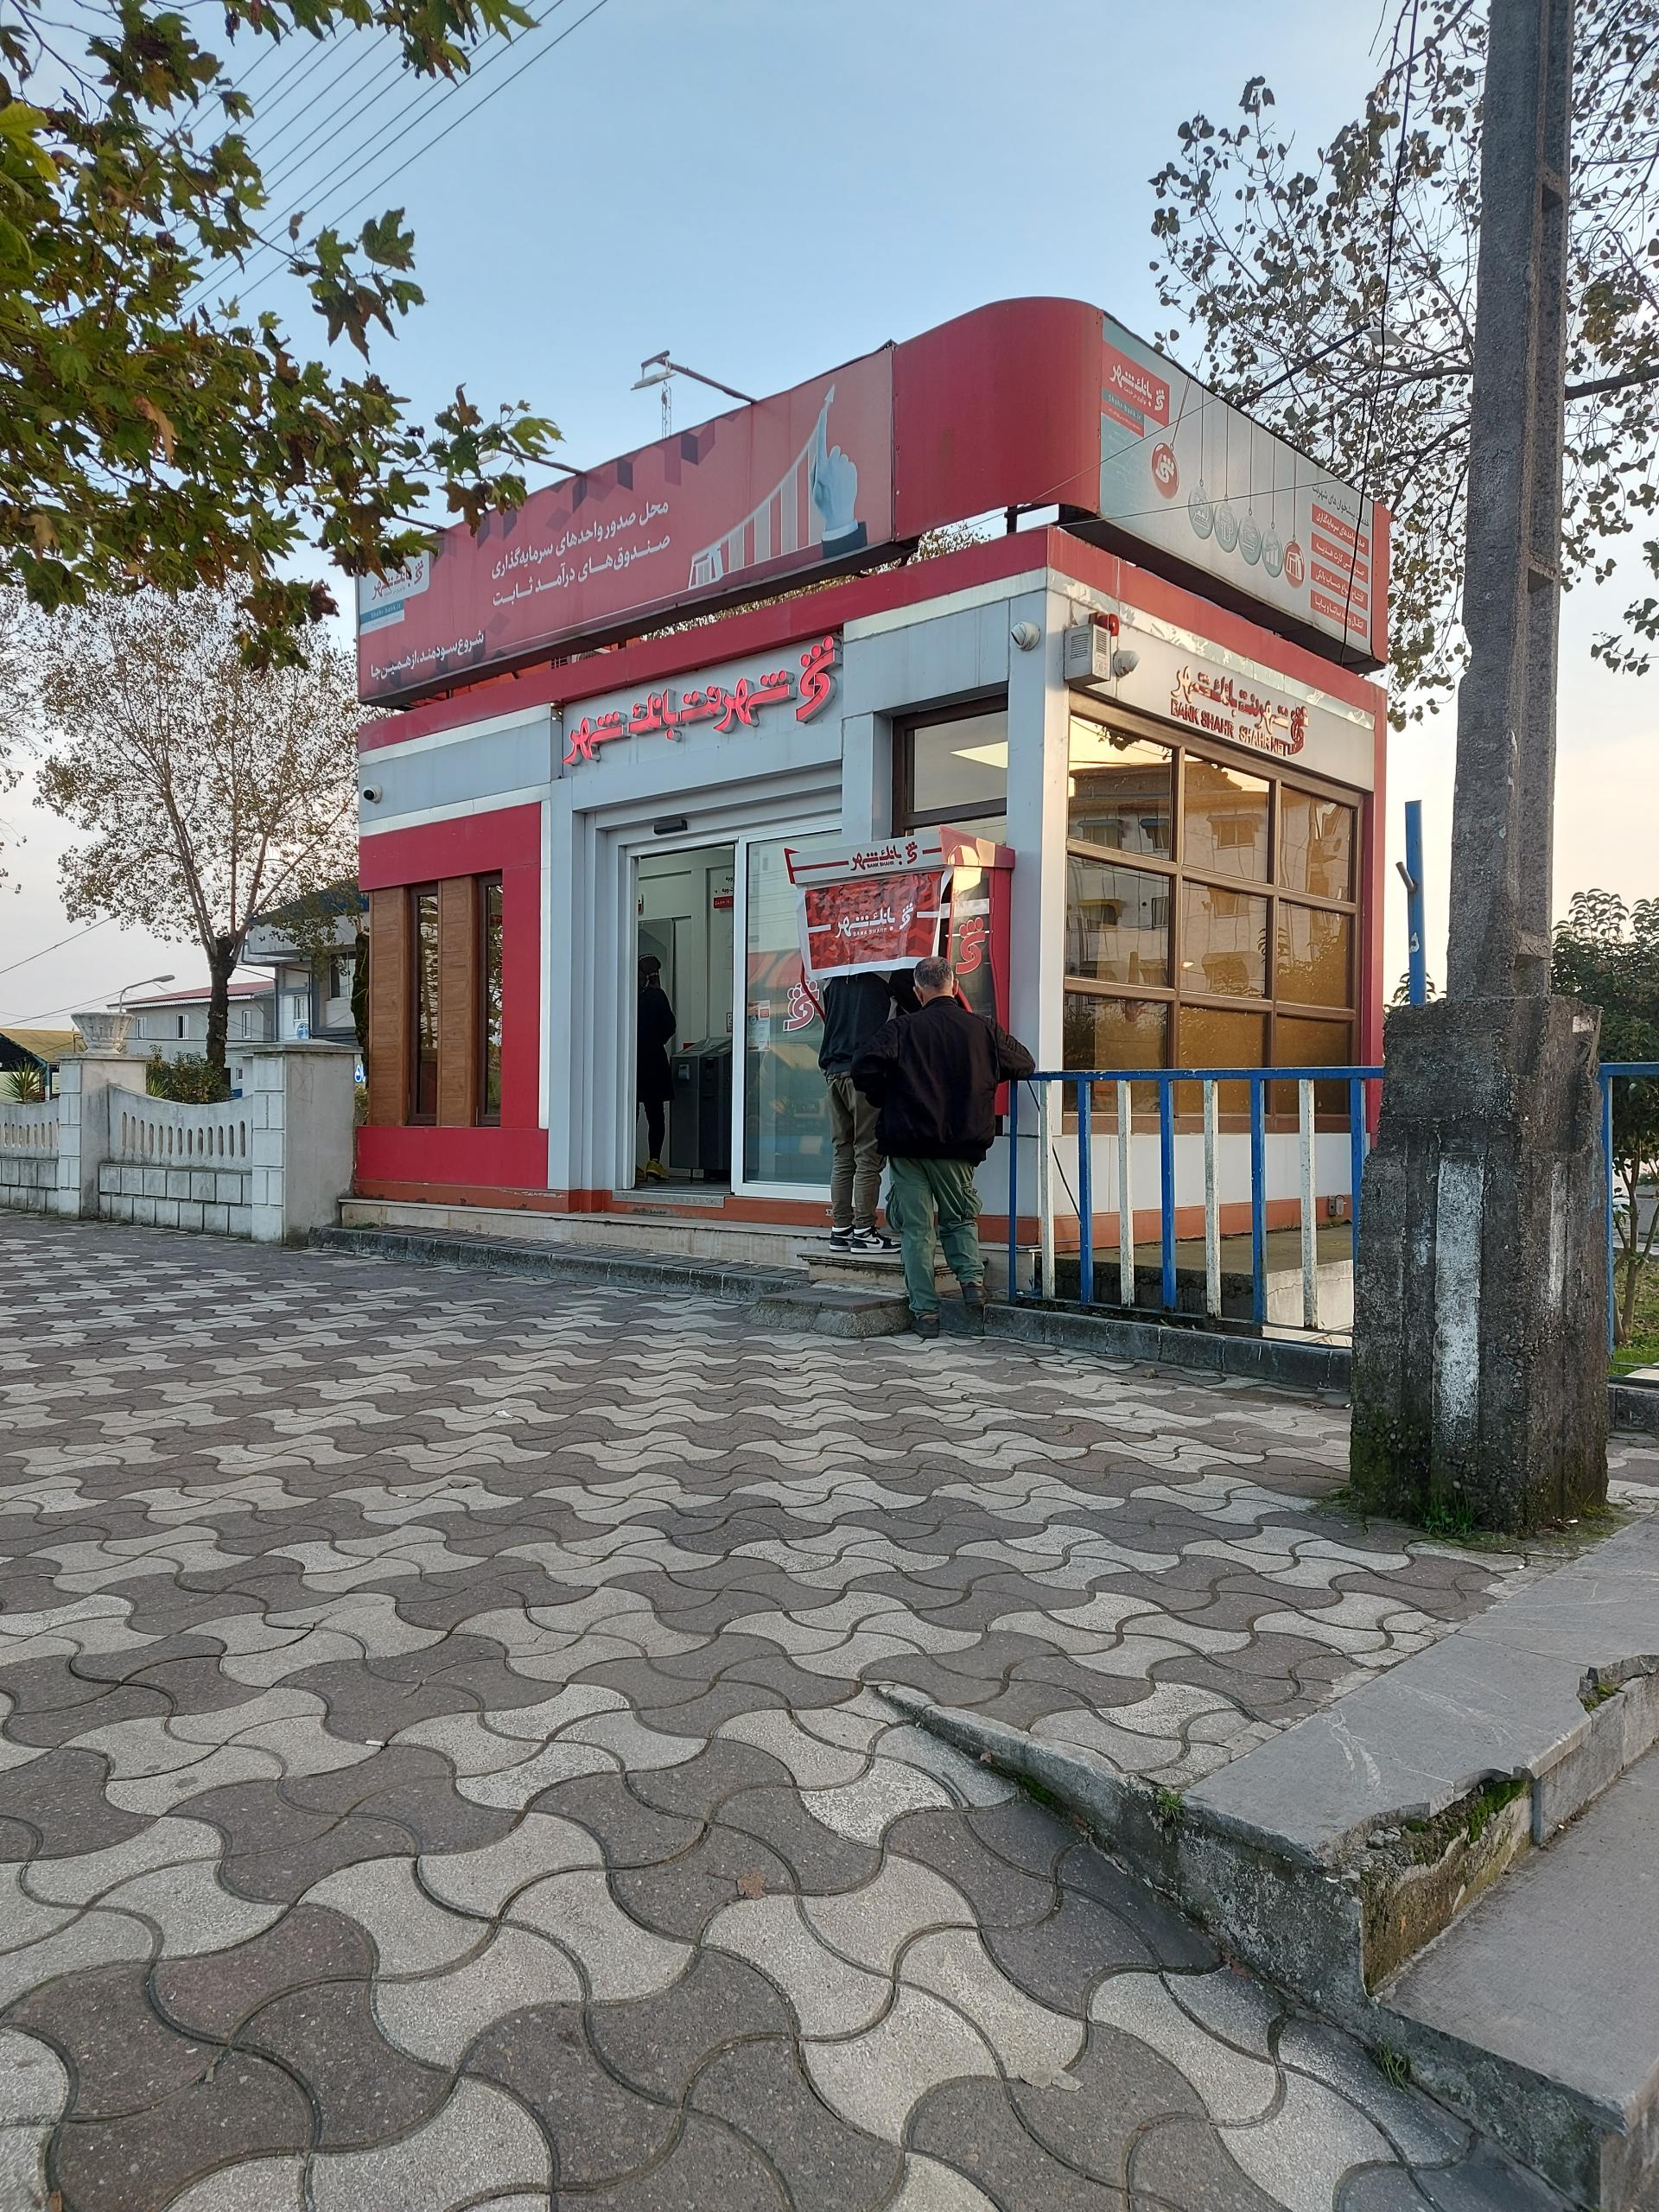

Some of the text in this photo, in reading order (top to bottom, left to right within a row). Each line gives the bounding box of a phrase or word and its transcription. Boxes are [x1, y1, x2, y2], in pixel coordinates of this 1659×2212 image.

[1109, 365, 1153, 407] بانک شهر
[605, 512, 636, 539] صدور
[639, 500, 668, 526] محل
[556, 521, 602, 556] واحدهای
[493, 576, 533, 606] ثابت
[535, 563, 575, 593] درآمد
[457, 630, 484, 655] شروع
[371, 664, 381, 680] جا
[380, 655, 411, 679] همین
[1171, 665, 1211, 704] شهر
[1211, 677, 1238, 718] بانک
[628, 689, 680, 742] بانک
[1171, 698, 1199, 725] BANK
[1200, 709, 1235, 739] SHAHR
[563, 711, 626, 766] شهر
[850, 844, 902, 871] بانک شهر
[835, 906, 895, 938] بانک شهر
